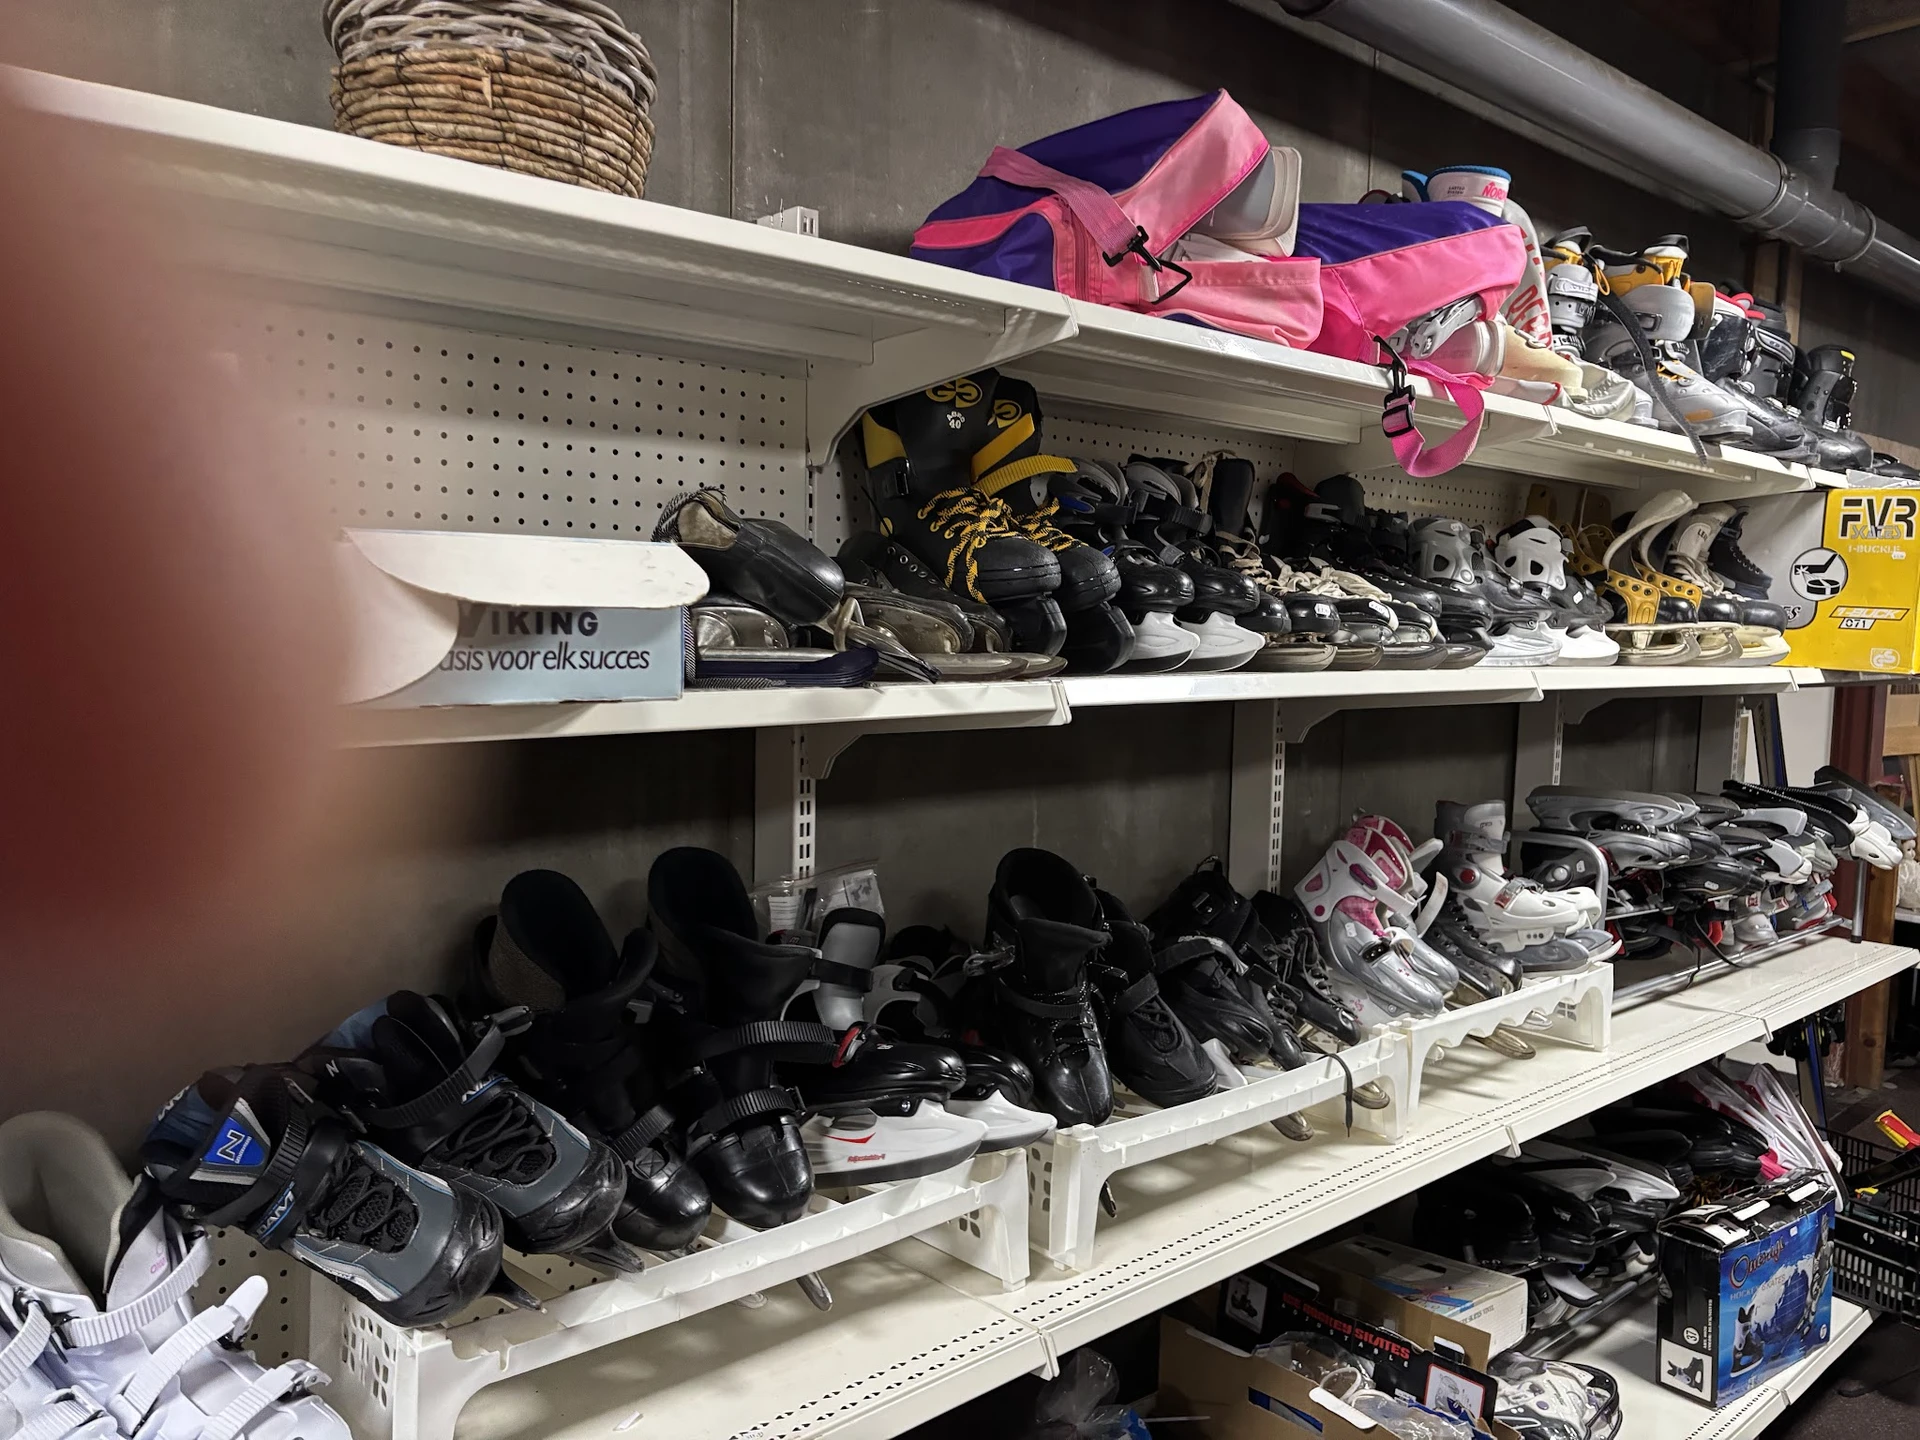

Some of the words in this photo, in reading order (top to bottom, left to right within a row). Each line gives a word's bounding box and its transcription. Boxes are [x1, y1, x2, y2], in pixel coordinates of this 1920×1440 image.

[949, 419, 962, 430] 40
[1839, 496, 1917, 540] FVR
[1850, 524, 1902, 540] SKATES
[459, 602, 599, 638] VIKING
[1845, 618, 1867, 628] 071
[439, 644, 483, 672] asis
[489, 650, 541, 671] voor
[543, 641, 577, 671] elk
[578, 650, 651, 671] succes
[1730, 1285, 1759, 1301] HOCKEY
[1761, 1274, 1786, 1291] SKATES
[1303, 1305, 1352, 1335] HOCKEY
[1355, 1328, 1410, 1359] SKATES
[1685, 1330, 1697, 1342] 37
